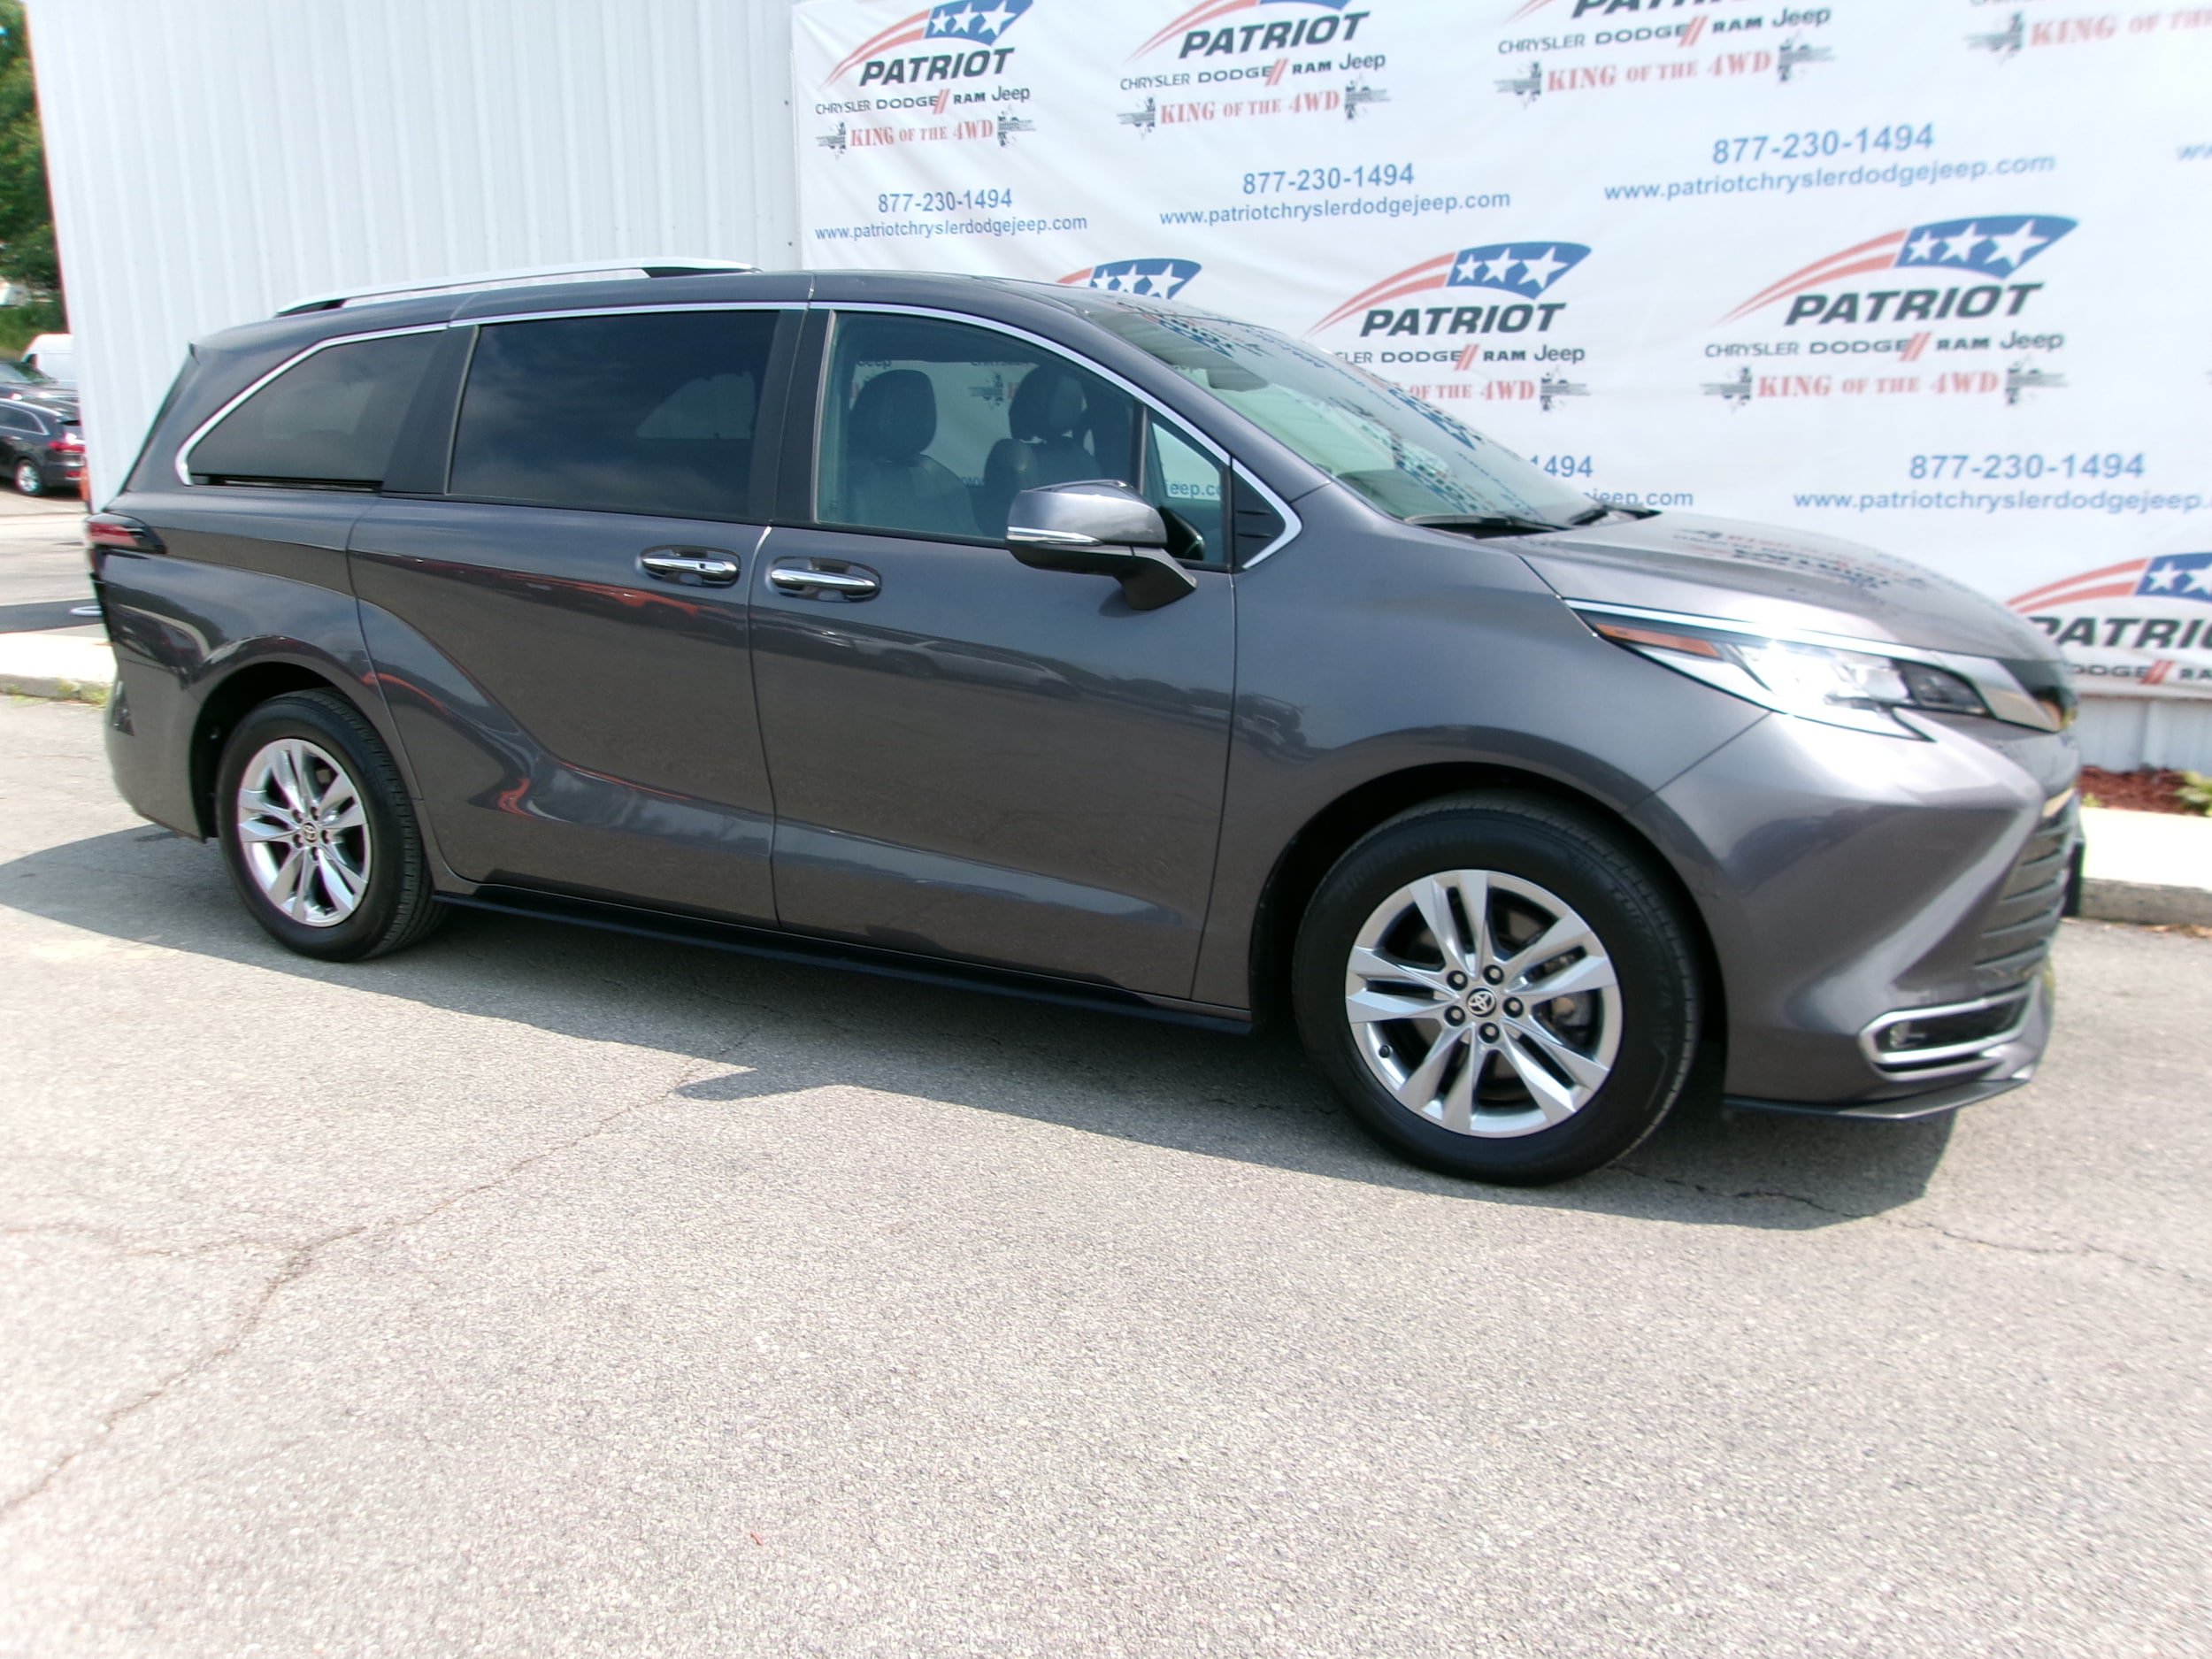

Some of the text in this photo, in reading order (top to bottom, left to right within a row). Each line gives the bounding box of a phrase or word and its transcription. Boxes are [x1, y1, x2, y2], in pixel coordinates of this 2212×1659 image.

[1179, 11, 1370, 58] PATRIOT
[1498, 7, 1832, 55] CHRYSLER DODGE RAM Jeep
[2031, 15, 2117, 47] KING
[859, 47, 1015, 87] PATRIOT
[1120, 53, 1386, 90] CHRYSLER DODGE RAM Jeep
[1548, 50, 1770, 92] KING OF THE 4WD
[816, 86, 1030, 115] CHRYSLER DODGE RAM Jeep
[1160, 90, 1340, 124] KING OF THE 4WD
[850, 119, 993, 146] KING OF THE 4WD
[1712, 122, 1934, 165] 877-230-1494
[1242, 163, 1414, 195] 877-230-1494
[1605, 154, 2056, 201] www.patriotchryslerdodgejeep.com
[878, 188, 1012, 213] 877-230-1494
[1160, 193, 1510, 227] www.patriotchryslerdodgejeep.com
[815, 217, 1087, 240] www.patriotchryslerdodgejeep.com
[1360, 303, 1567, 337] PATRIOT
[1784, 282, 2045, 326] PATRIOT
[1381, 350, 1463, 363] DODGE
[1483, 350, 1525, 361] RAM
[1534, 345, 1585, 364] Jeep
[1705, 331, 2064, 357] CHRYSLER DODGE RAM Jeep
[1409, 385, 1431, 400] OF
[1435, 384, 1473, 398] THE
[1482, 380, 1535, 401] 4WD
[1757, 371, 1999, 398] KING OF THE 4WD
[1909, 452, 2145, 480] 877-230-1494
[1793, 489, 2212, 514] www.patriotchryslerdodgejeep.
